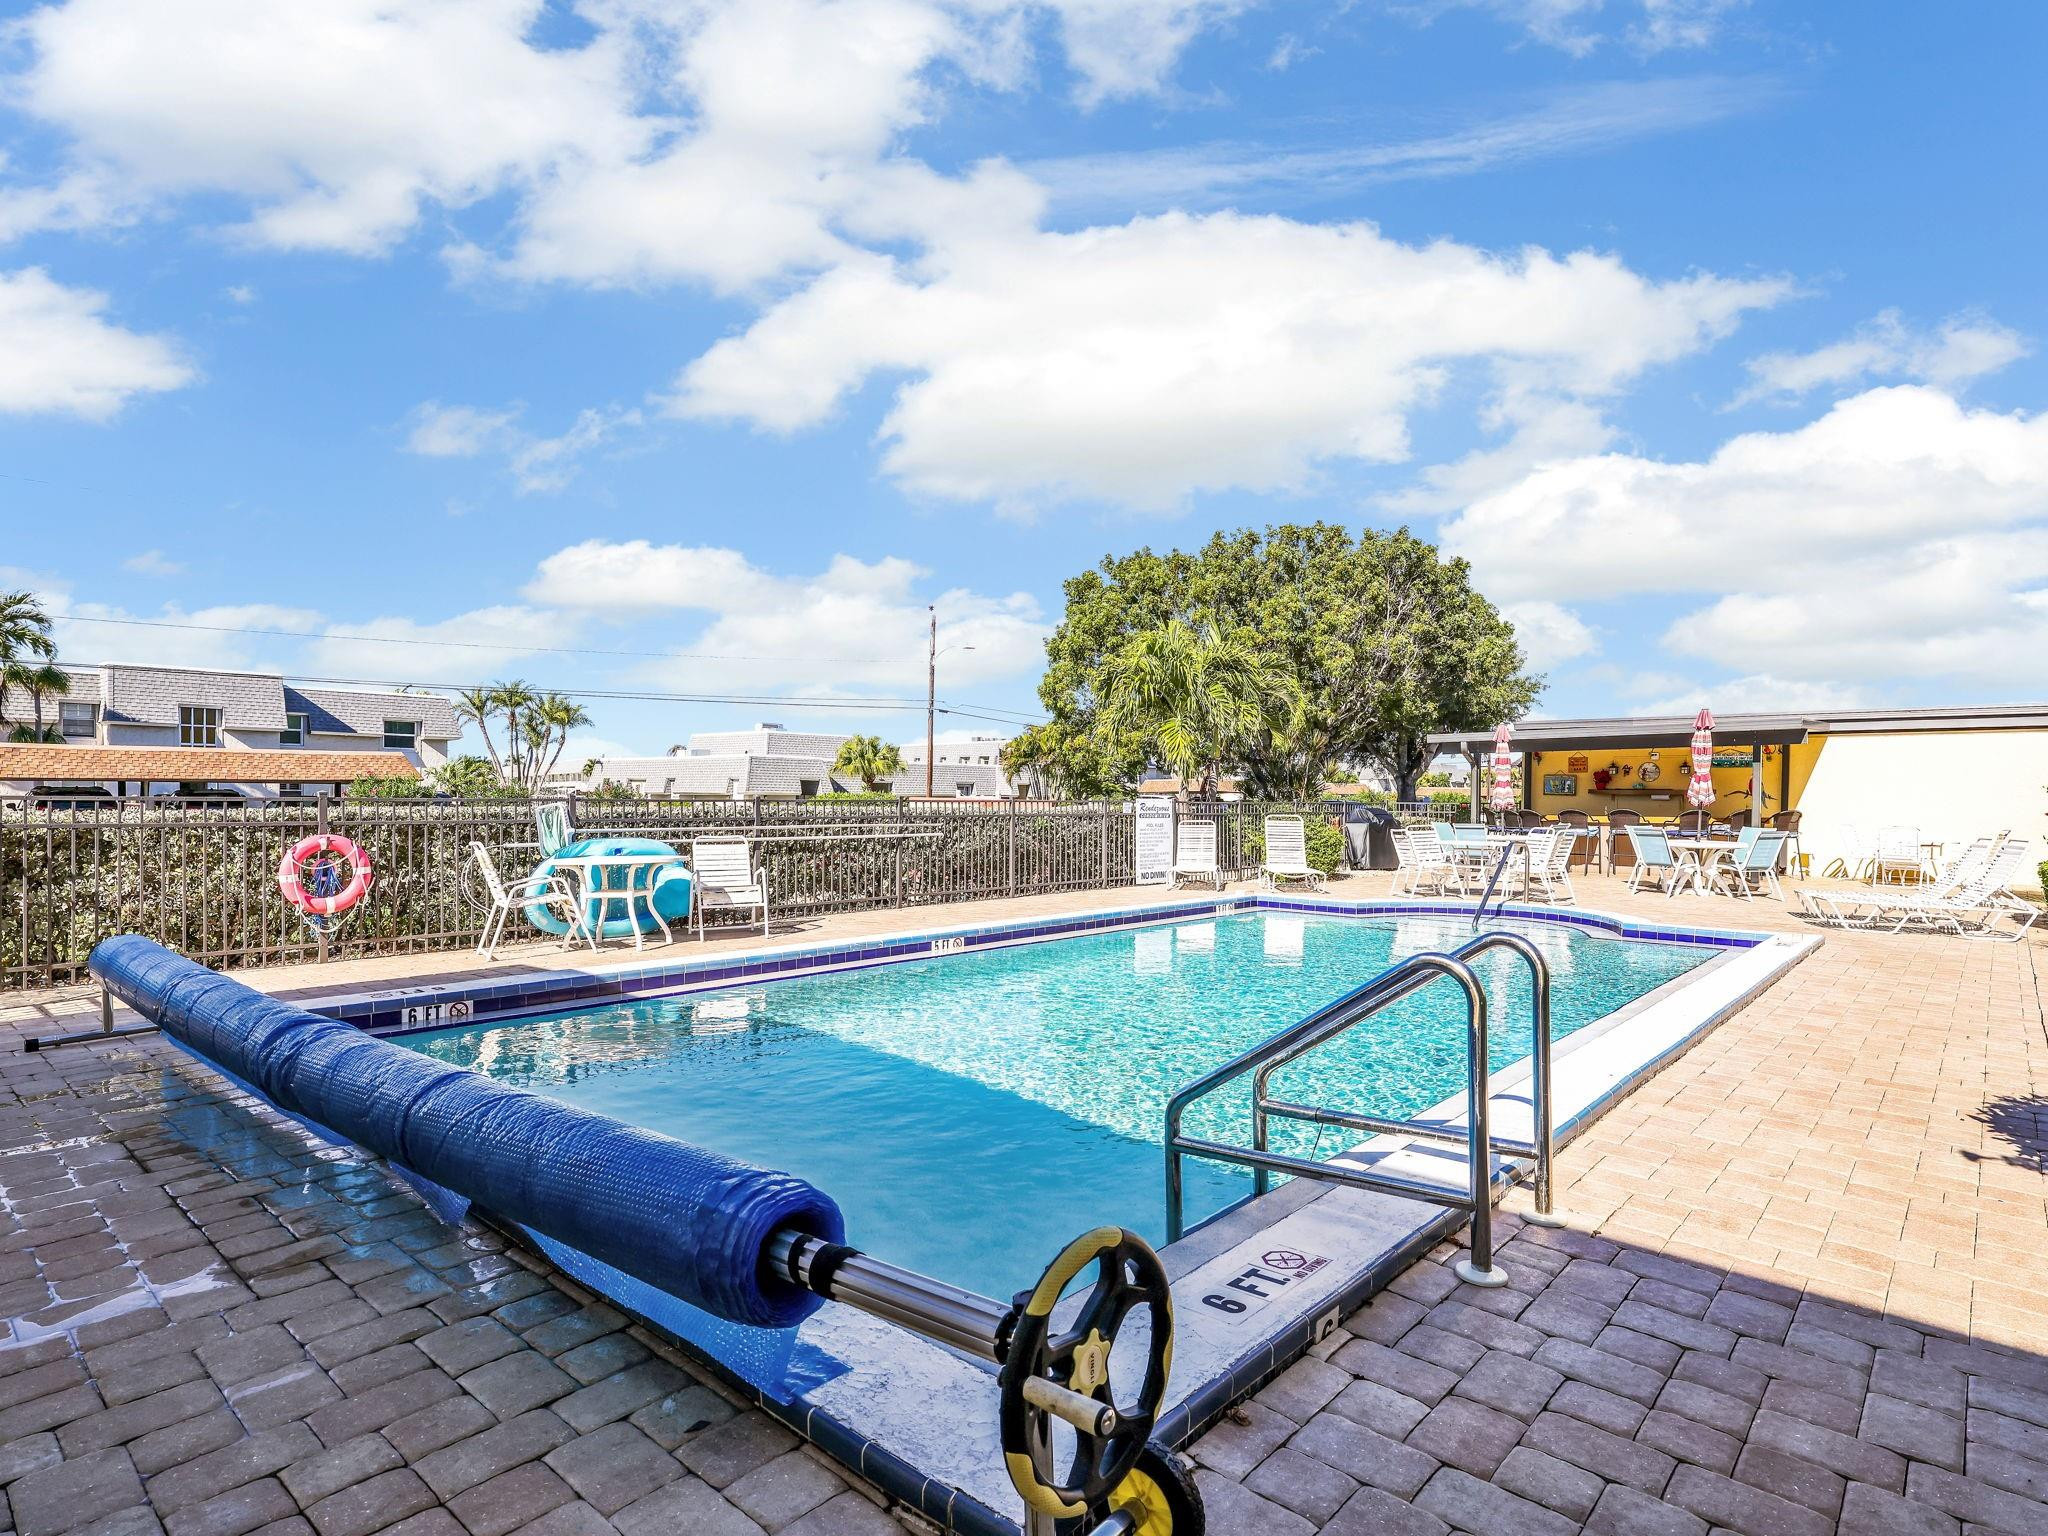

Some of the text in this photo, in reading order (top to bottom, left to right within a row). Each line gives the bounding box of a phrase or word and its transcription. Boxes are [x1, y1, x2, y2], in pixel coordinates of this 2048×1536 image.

[1141, 872, 1150, 880] NO
[934, 940, 950, 950] 5 FT
[408, 1005, 441, 1023] 6 FT
[1202, 1294, 1247, 1314] 6
